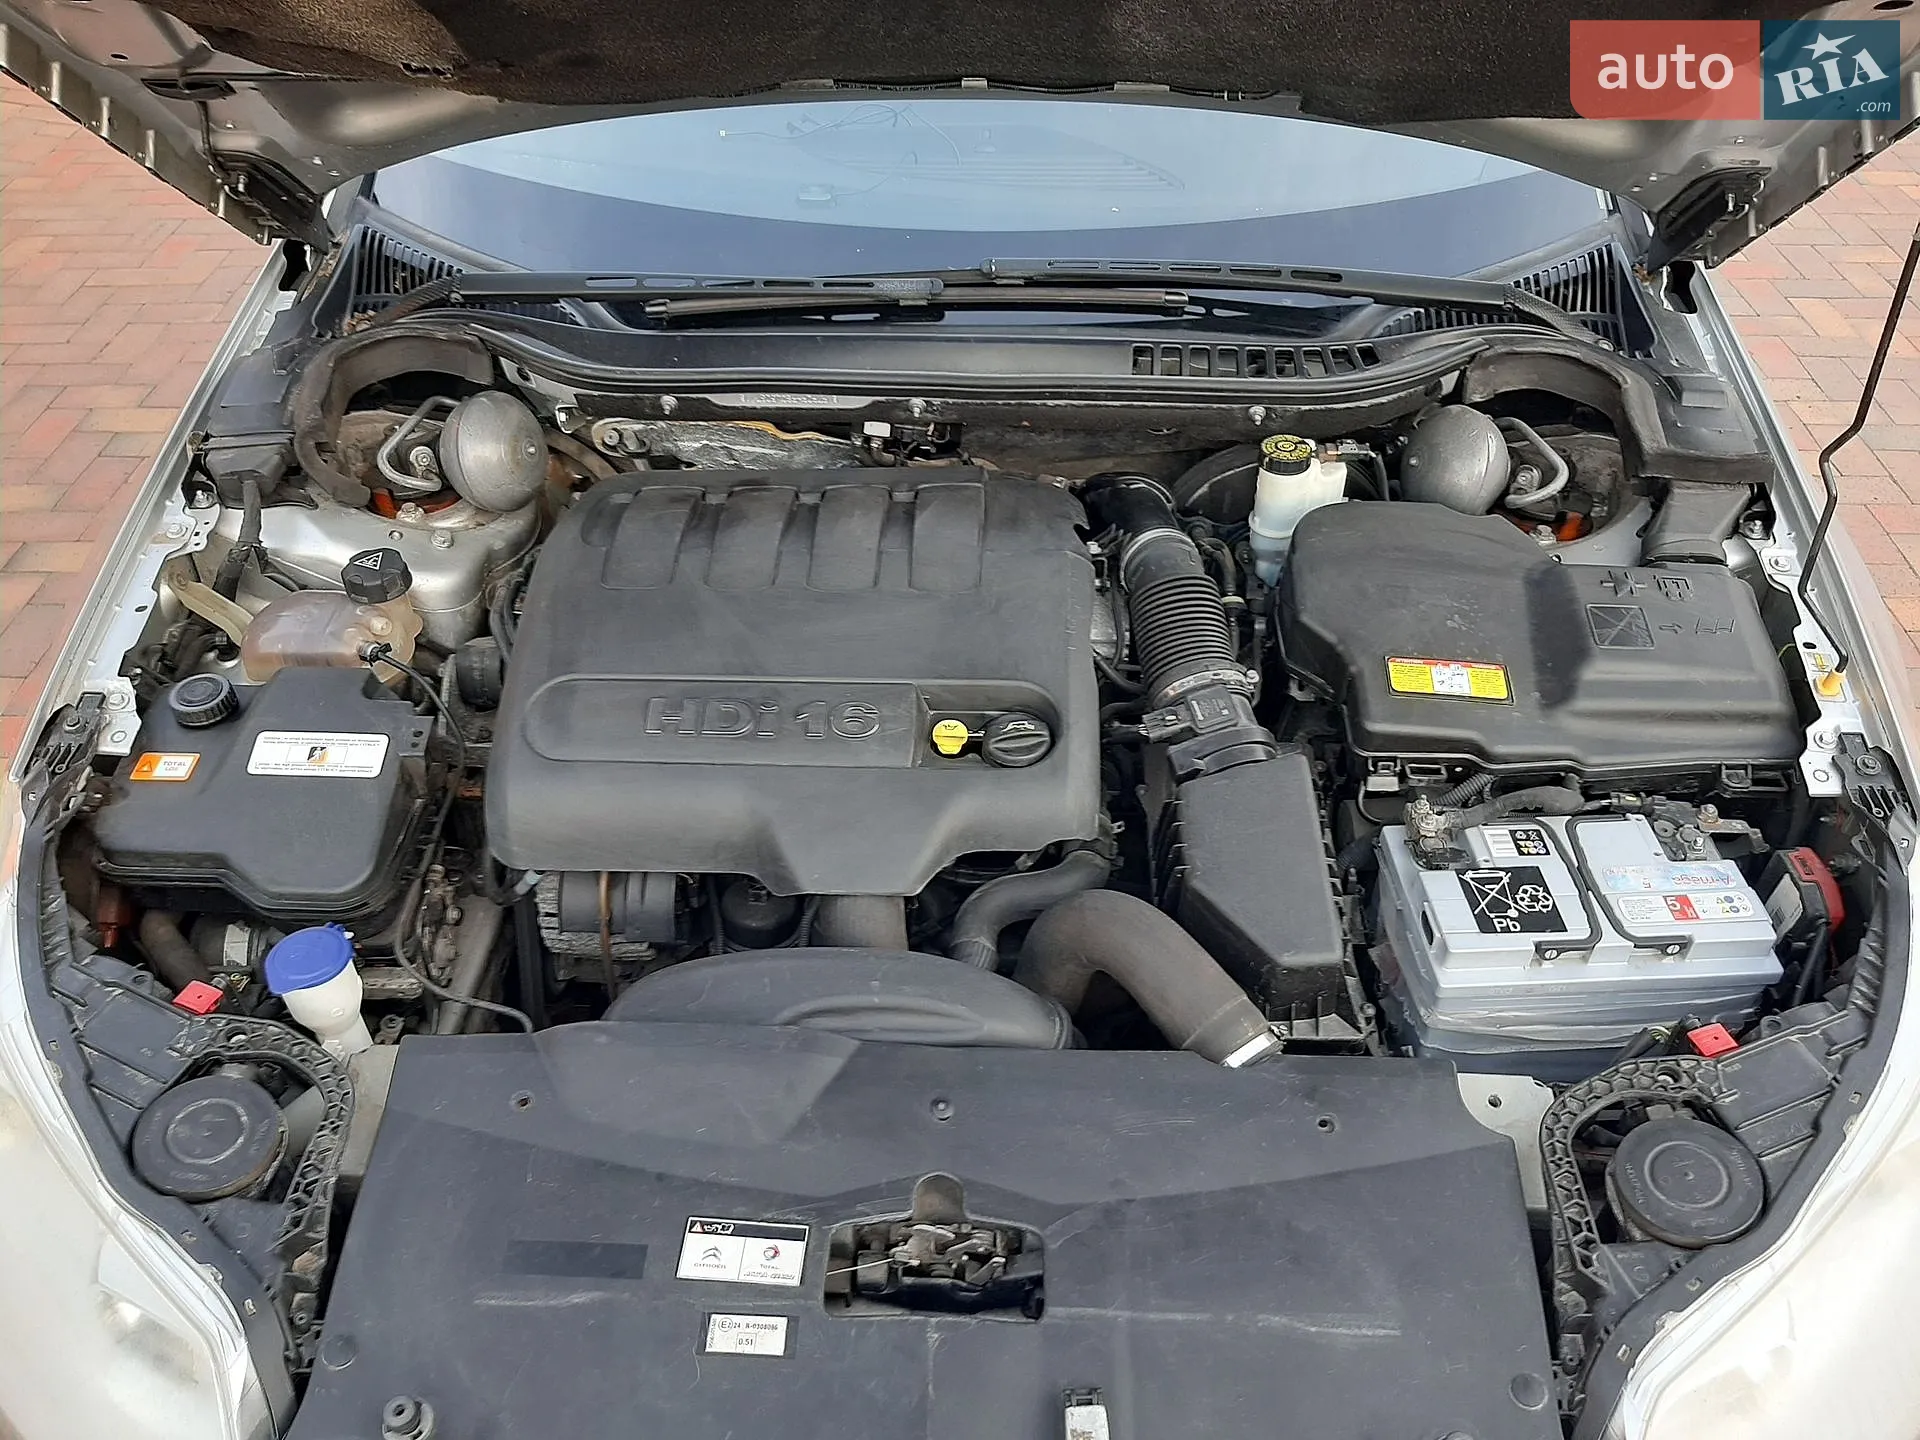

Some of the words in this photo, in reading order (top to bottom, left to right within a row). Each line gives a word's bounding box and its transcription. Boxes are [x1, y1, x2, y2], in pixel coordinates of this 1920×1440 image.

[645, 697, 779, 739] HDi
[794, 700, 882, 742] 16
[1492, 918, 1521, 933] Pb
